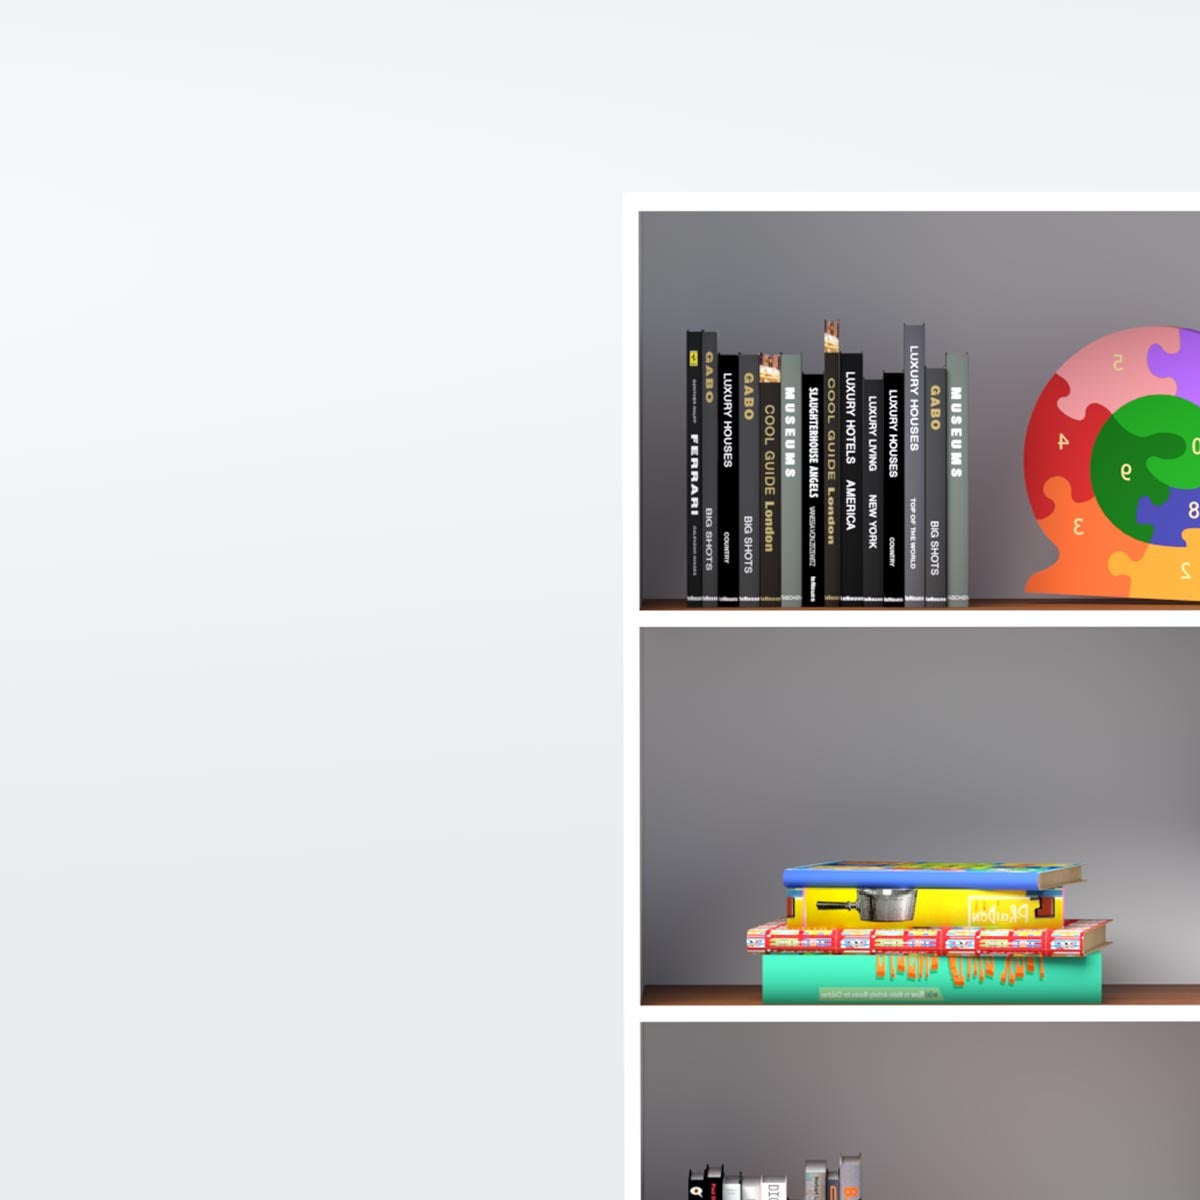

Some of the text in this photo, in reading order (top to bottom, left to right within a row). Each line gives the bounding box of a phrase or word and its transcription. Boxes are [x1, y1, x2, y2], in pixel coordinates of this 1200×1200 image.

[705, 351, 714, 404] GABO
[723, 373, 732, 468] LUXURY HOUSES
[744, 372, 754, 420] GABO
[910, 346, 918, 451] LUXURY HOUSES
[930, 385, 940, 430] GABO
[690, 434, 699, 516] FERRARI
[784, 387, 796, 478] MUSEUMS
[808, 387, 818, 498] SLAUGHTERHOUSE ANGELS
[828, 378, 836, 544] COOL GUIDE London
[846, 372, 856, 530] LUXURY HOTELS AMERICA
[868, 396, 878, 549] LUXURY LIVING NEW YORK
[888, 390, 898, 478] LUXURY HOUSES
[951, 387, 962, 478] MUSEUMS
[764, 404, 775, 552] COOL GUIDE London
[910, 514, 916, 524] OF
[705, 508, 713, 571] BIG SHOTS
[744, 516, 752, 574] BIG SHOTS
[930, 521, 939, 576] BIG SHOTS
